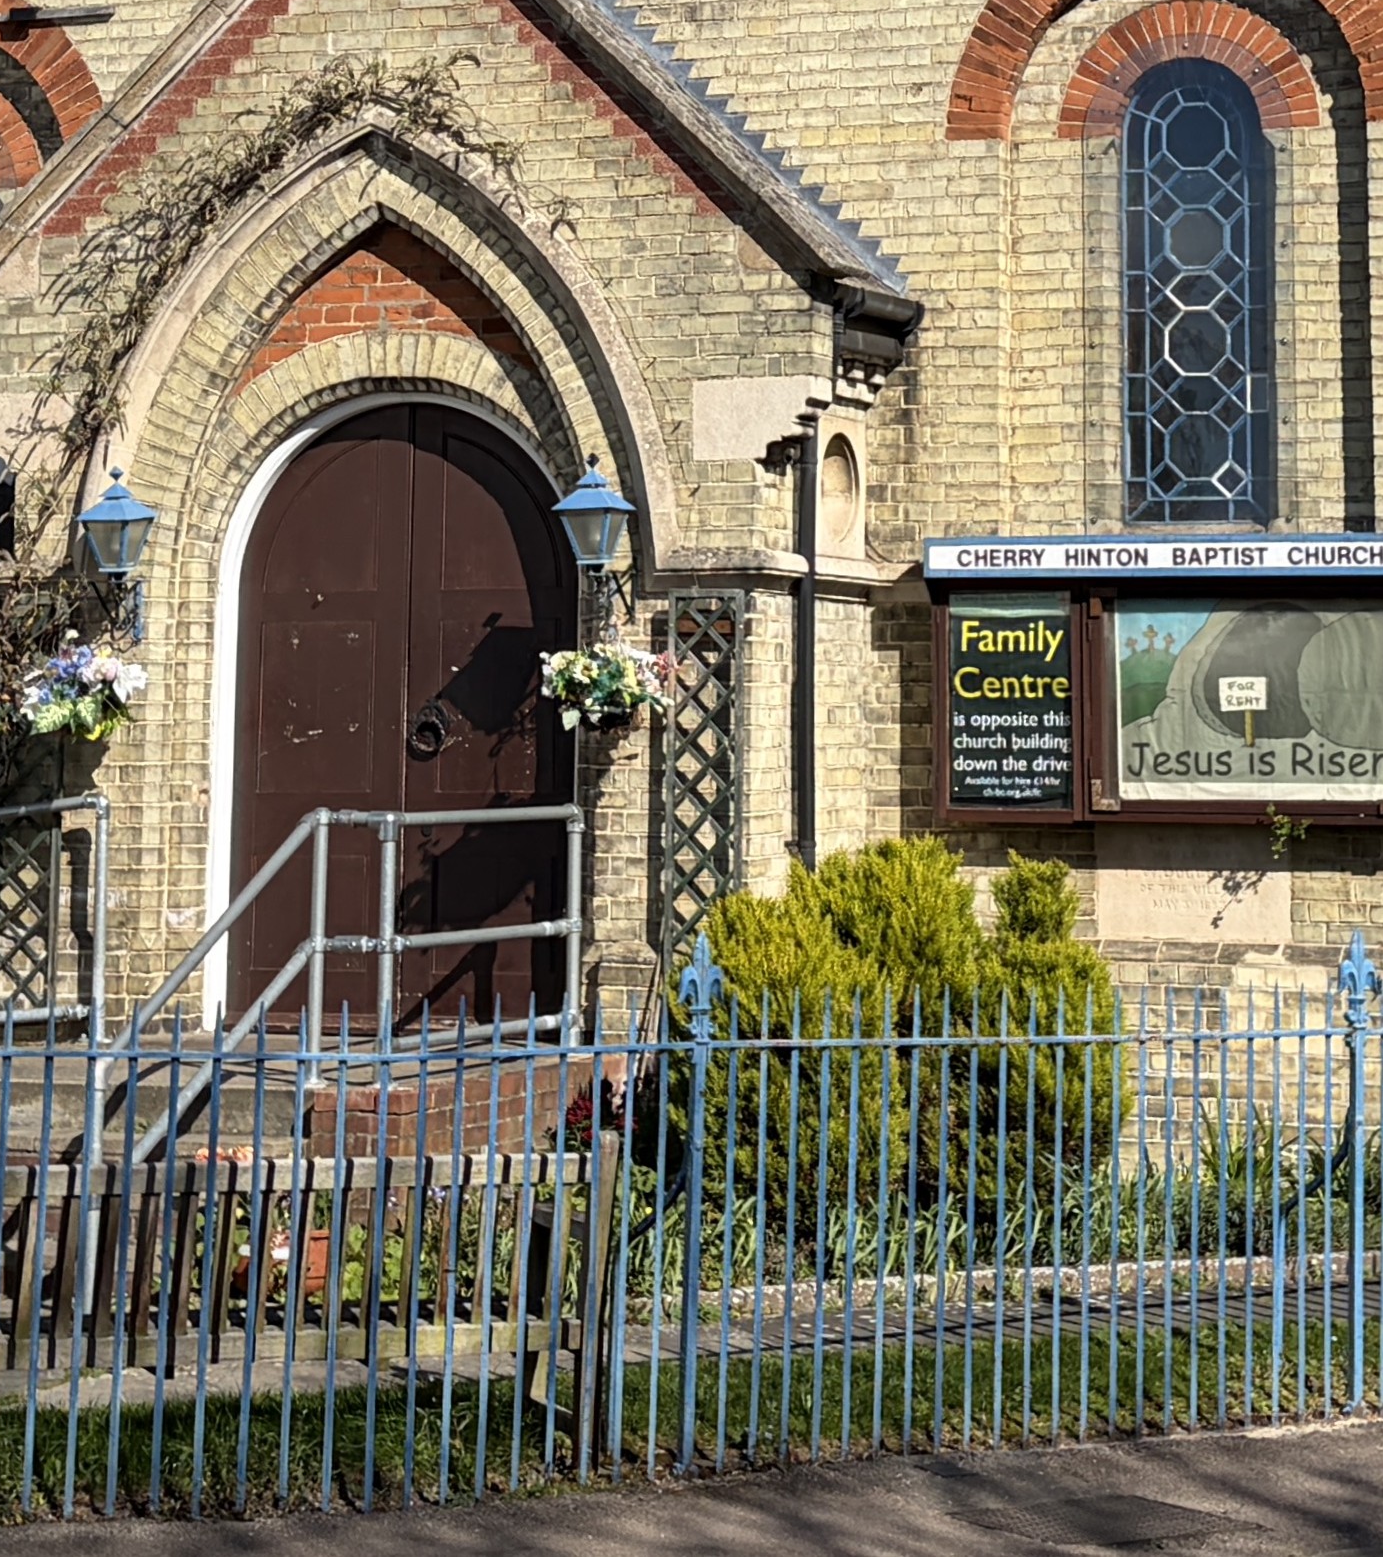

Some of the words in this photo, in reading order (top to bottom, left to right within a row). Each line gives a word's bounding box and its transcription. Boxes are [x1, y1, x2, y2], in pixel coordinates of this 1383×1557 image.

[956, 548, 1046, 568] CHERRY
[1064, 547, 1149, 567] HINTON
[1171, 546, 1269, 566] BAPTIST
[960, 619, 1065, 662] Family
[953, 666, 1071, 699] Centre
[1226, 680, 1257, 692] FOR
[1224, 695, 1263, 708] RENT
[953, 711, 966, 727] is
[970, 710, 1039, 732] opposite
[1043, 710, 1072, 727] this
[953, 732, 1007, 749] church
[1011, 732, 1072, 754] building
[953, 754, 998, 772] down
[1002, 755, 1028, 772] the
[1032, 754, 1072, 772] drive
[1126, 741, 1233, 778] Jesus
[1246, 746, 1277, 777] is
